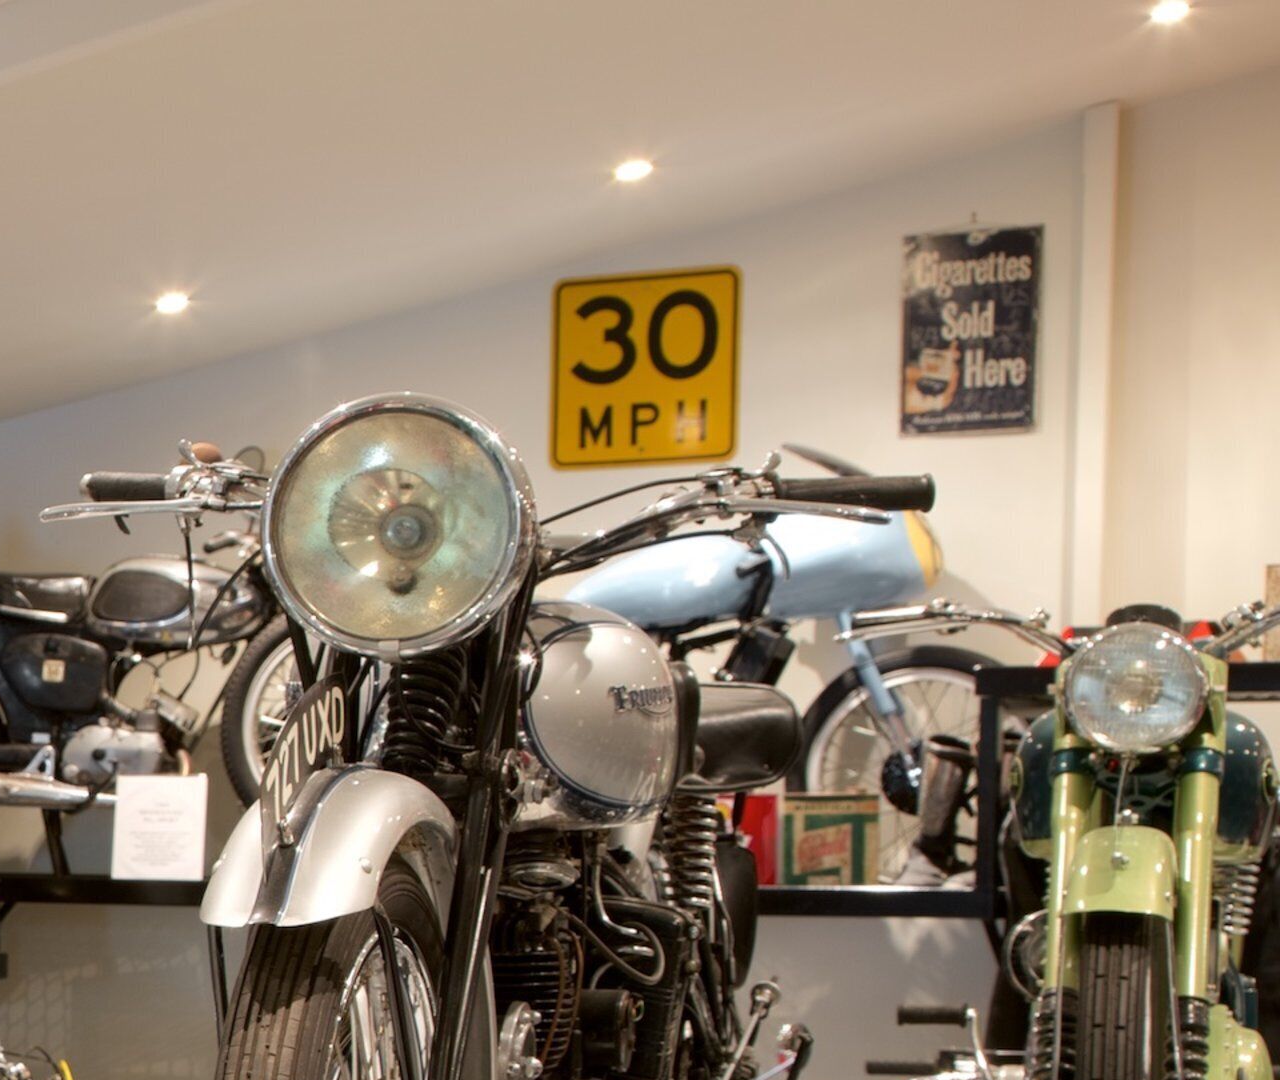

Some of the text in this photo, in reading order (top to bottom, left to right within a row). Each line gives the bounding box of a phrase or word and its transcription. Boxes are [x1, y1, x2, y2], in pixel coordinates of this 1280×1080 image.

[913, 251, 1033, 298] Cigarettes
[571, 289, 720, 385] 30
[941, 300, 995, 341] Sold
[963, 348, 1027, 389] Here
[579, 397, 708, 449] MPH
[266, 686, 345, 823] 727 UXD
